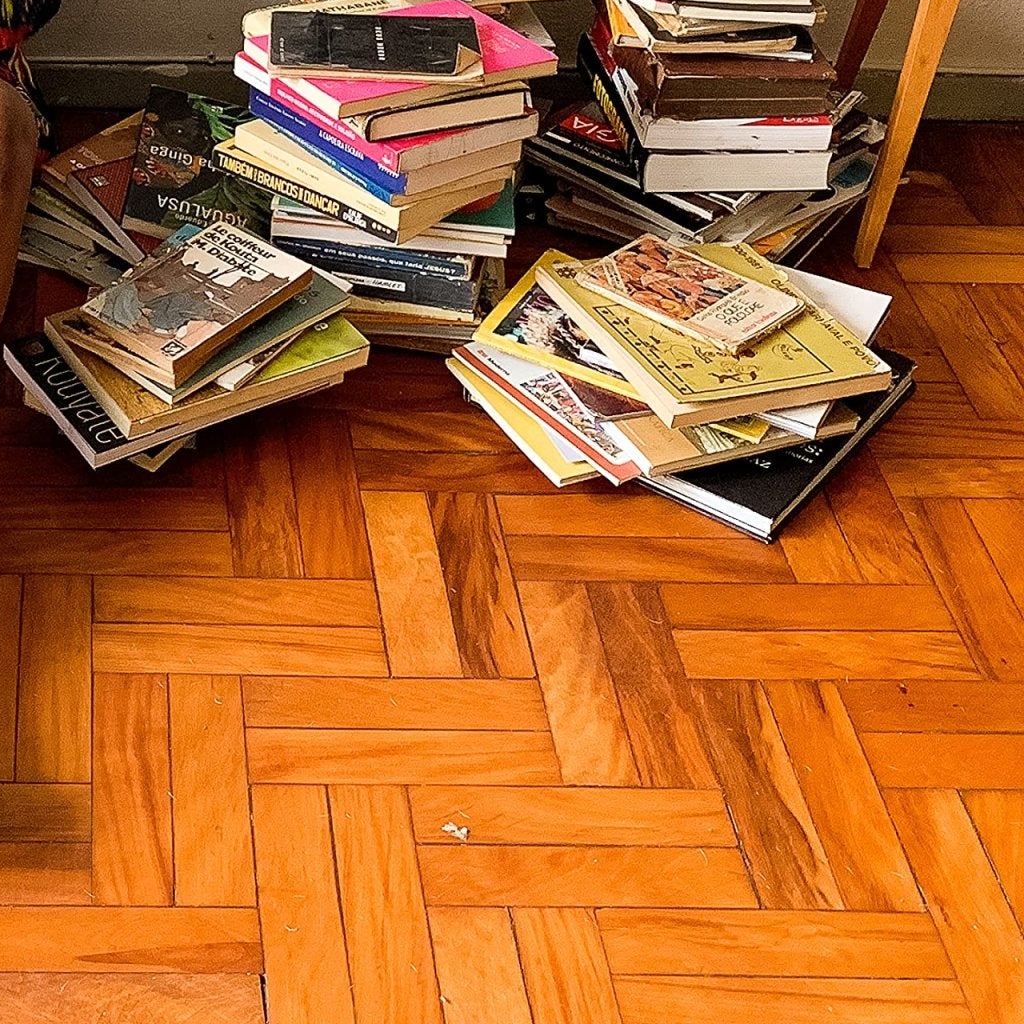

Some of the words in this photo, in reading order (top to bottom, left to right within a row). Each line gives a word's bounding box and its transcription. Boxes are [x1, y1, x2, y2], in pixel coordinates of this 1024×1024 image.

[149, 145, 193, 165] Ginga
[216, 153, 254, 180] TAMBÉM
[256, 169, 300, 198] BRANCOS
[302, 190, 341, 217] DANÇAR
[156, 194, 248, 228] AGUALUSA
[174, 214, 208, 227] Eduardo
[191, 236, 209, 251] M.
[203, 228, 222, 244] de
[220, 238, 259, 265] Kouta
[212, 223, 228, 237] Le
[227, 230, 277, 264] coiffeur
[337, 250, 356, 258] seus
[389, 259, 404, 267] que
[405, 261, 423, 269] faria
[424, 265, 456, 275] JESUS?
[842, 338, 853, 348] E
